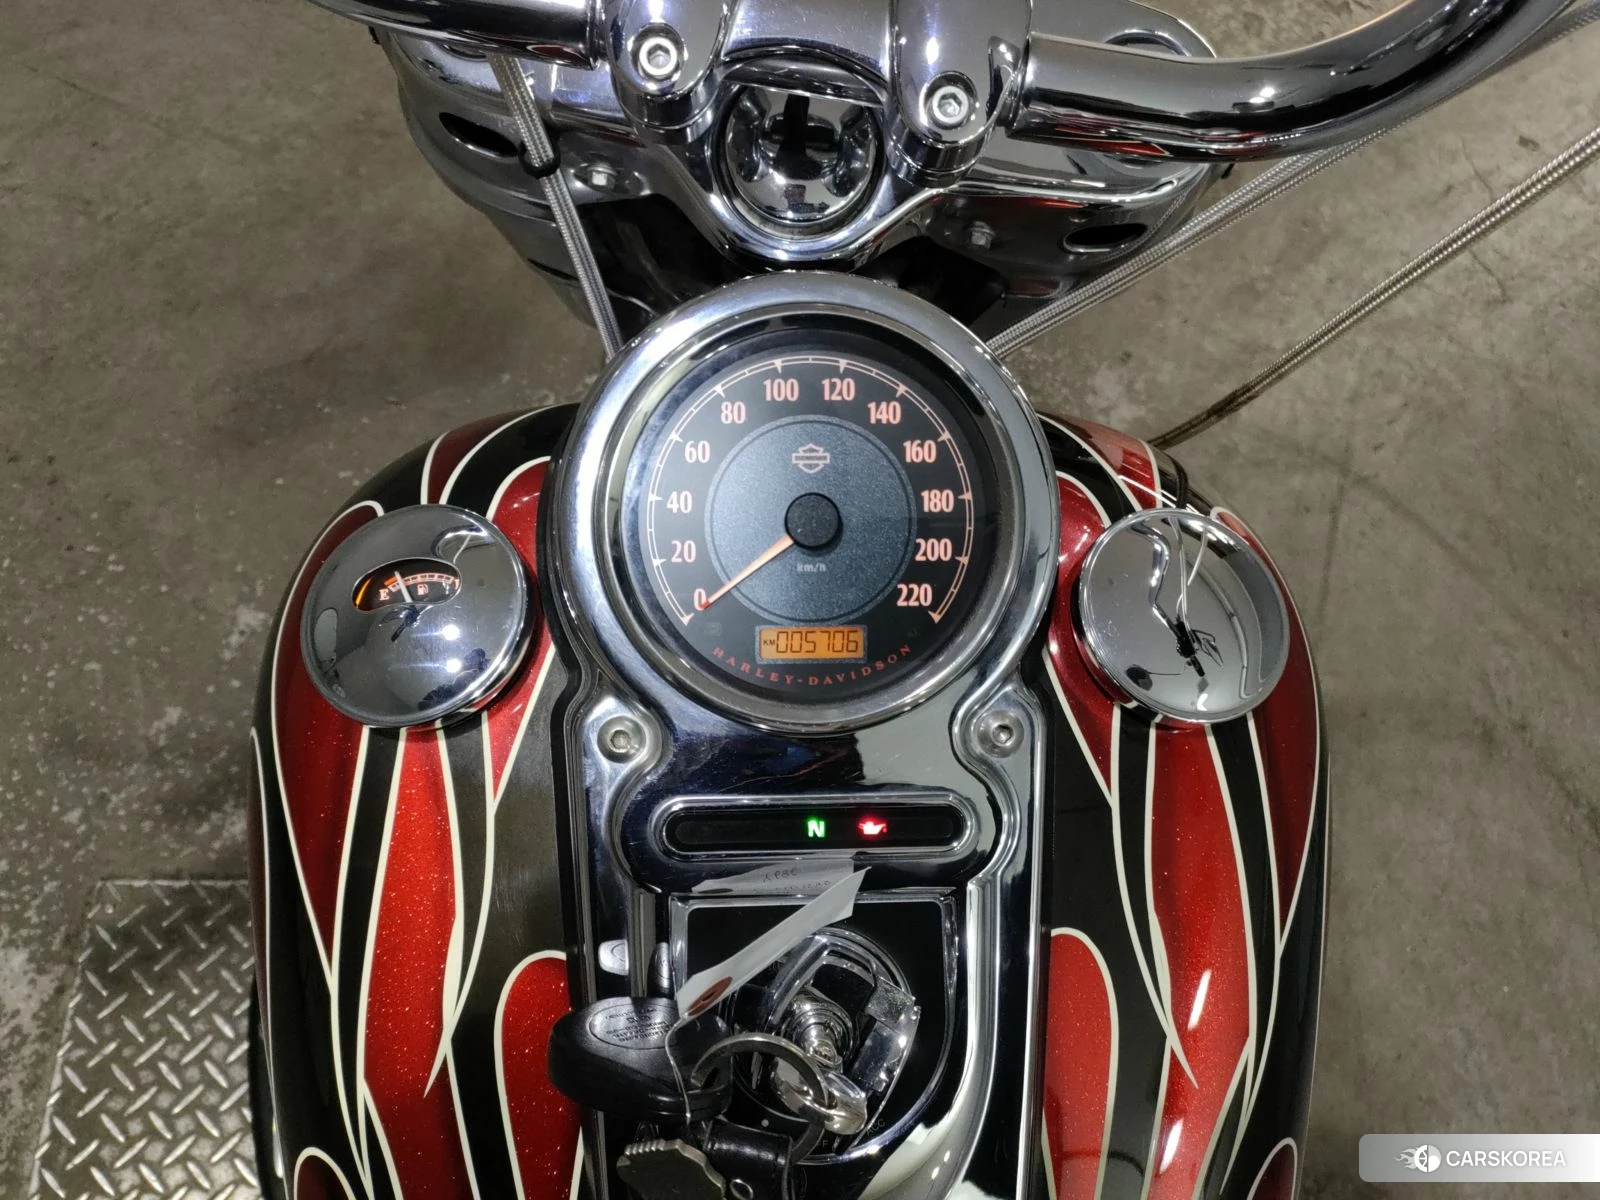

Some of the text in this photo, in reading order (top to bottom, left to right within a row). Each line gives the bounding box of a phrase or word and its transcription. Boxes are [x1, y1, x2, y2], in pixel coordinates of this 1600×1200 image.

[763, 378, 799, 402] 100
[821, 378, 855, 401] 120
[720, 402, 746, 424] 80
[867, 401, 901, 424] 140
[684, 440, 710, 463] 60
[903, 440, 936, 463] 160
[667, 491, 692, 513] 40
[921, 490, 954, 513] 180
[671, 540, 696, 563] 20
[915, 538, 952, 561] 200
[379, 589, 390, 600] E
[693, 588, 707, 611] 0
[897, 584, 932, 607] 220
[776, 630, 858, 653] 005706
[807, 820, 825, 838] N
